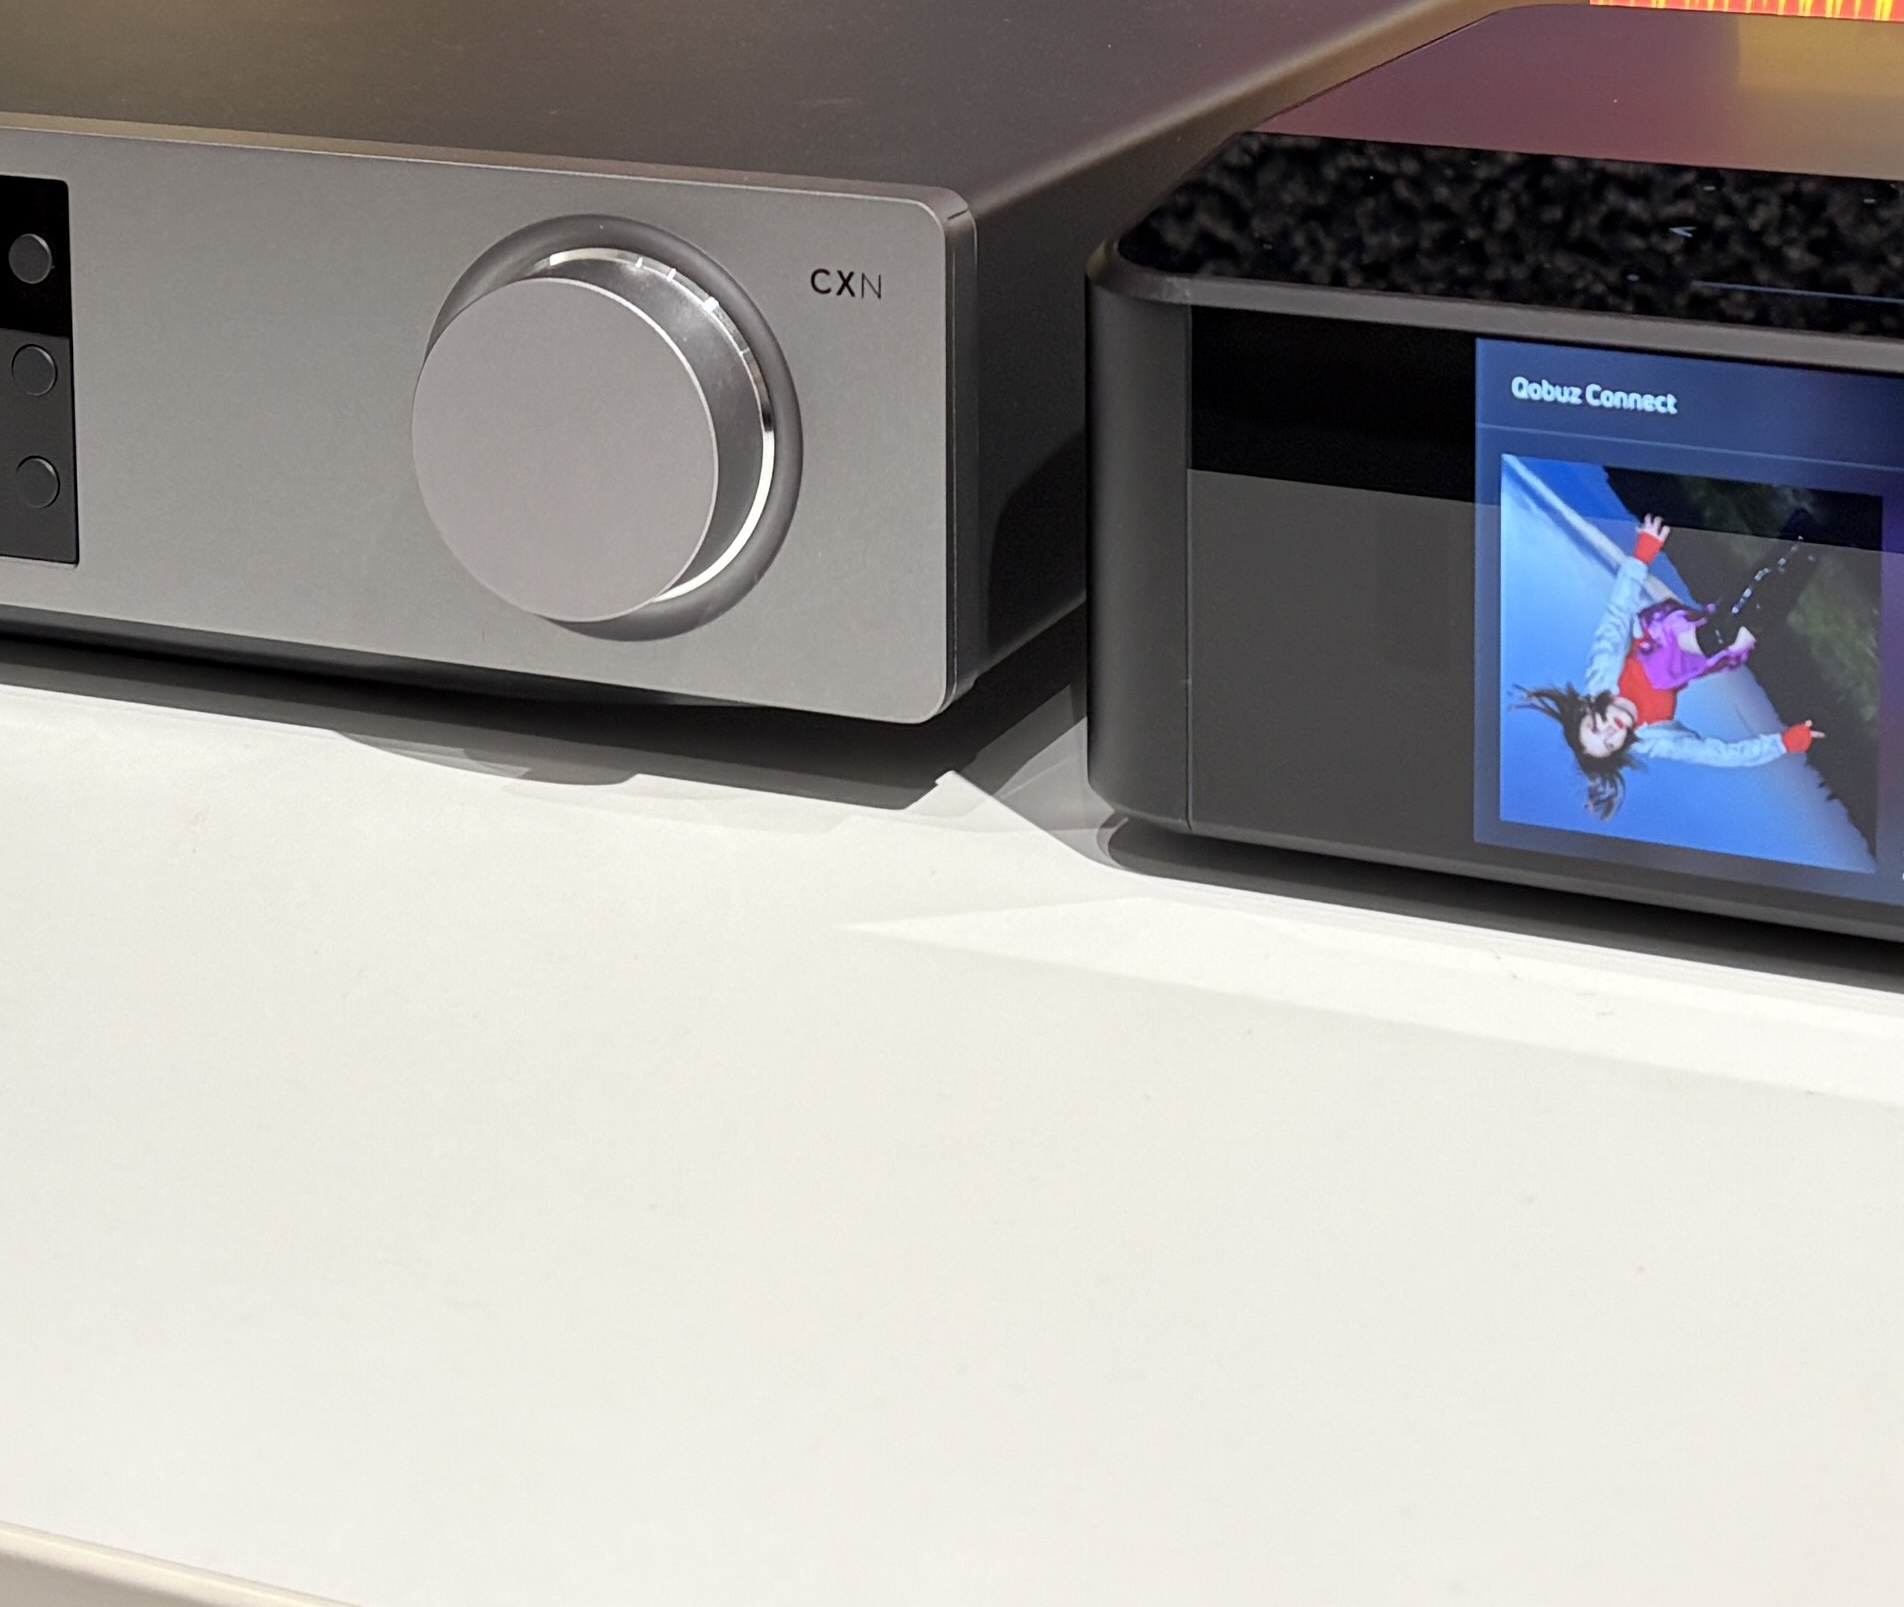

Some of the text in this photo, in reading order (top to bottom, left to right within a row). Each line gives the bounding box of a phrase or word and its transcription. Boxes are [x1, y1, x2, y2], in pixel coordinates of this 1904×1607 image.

[810, 268, 883, 301] CXN
[1511, 376, 1678, 415] Qobuz Connect
